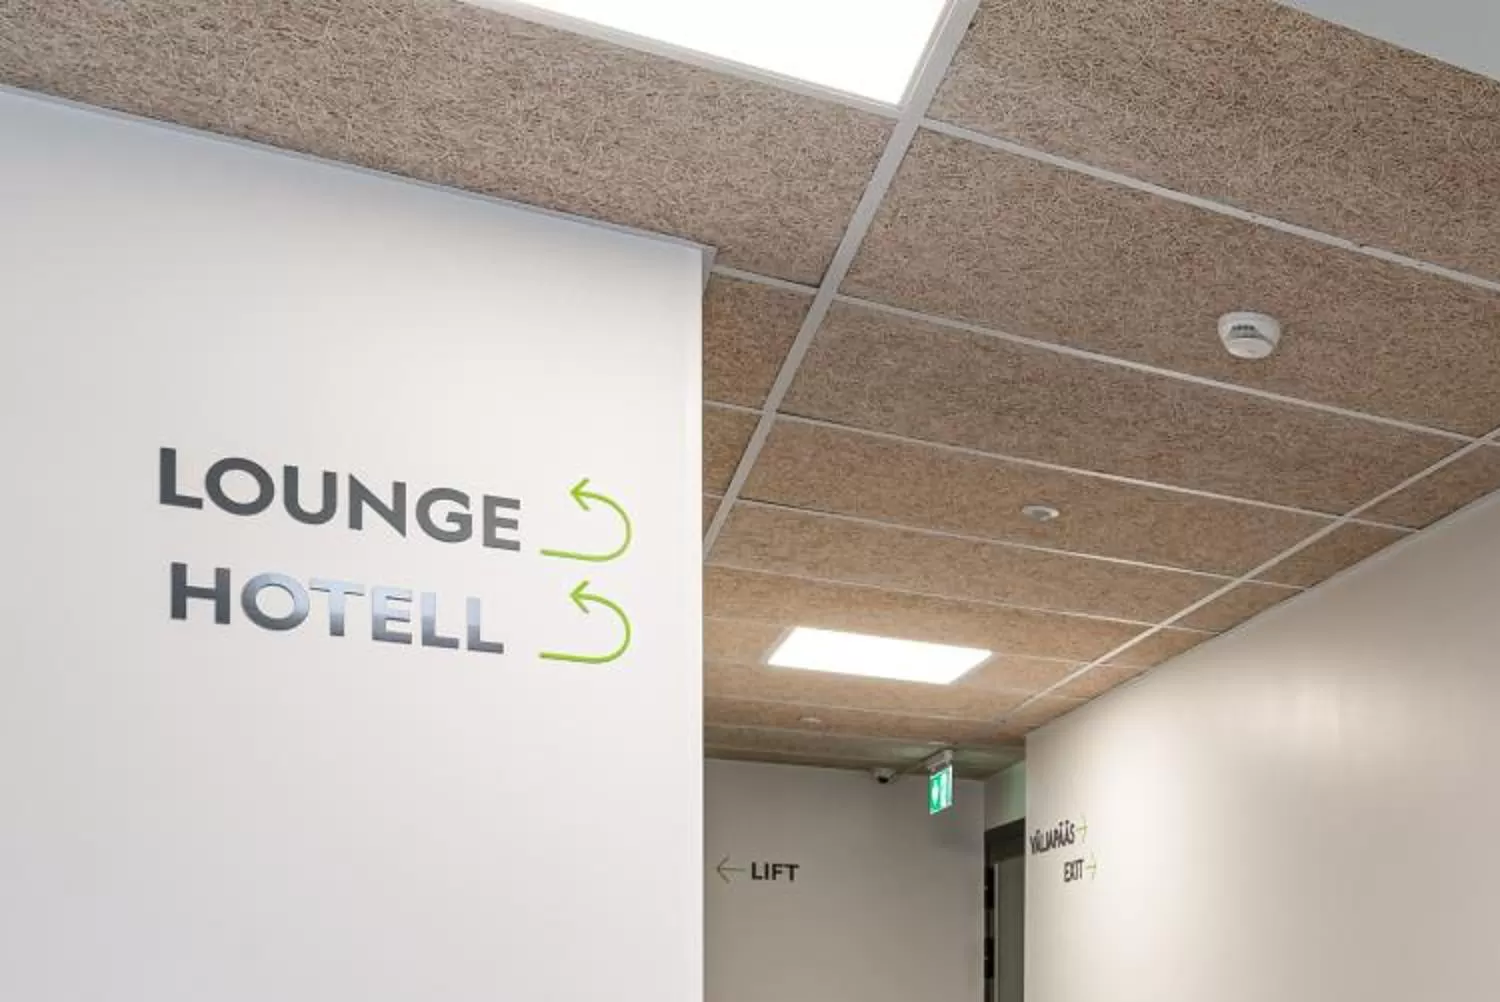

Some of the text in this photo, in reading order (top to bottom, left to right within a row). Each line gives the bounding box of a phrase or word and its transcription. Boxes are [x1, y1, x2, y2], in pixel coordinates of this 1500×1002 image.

[159, 446, 521, 552] LOUNGE
[170, 561, 504, 654] HOTELL
[751, 861, 800, 882] LIFT
[1063, 858, 1084, 883] EXIT
